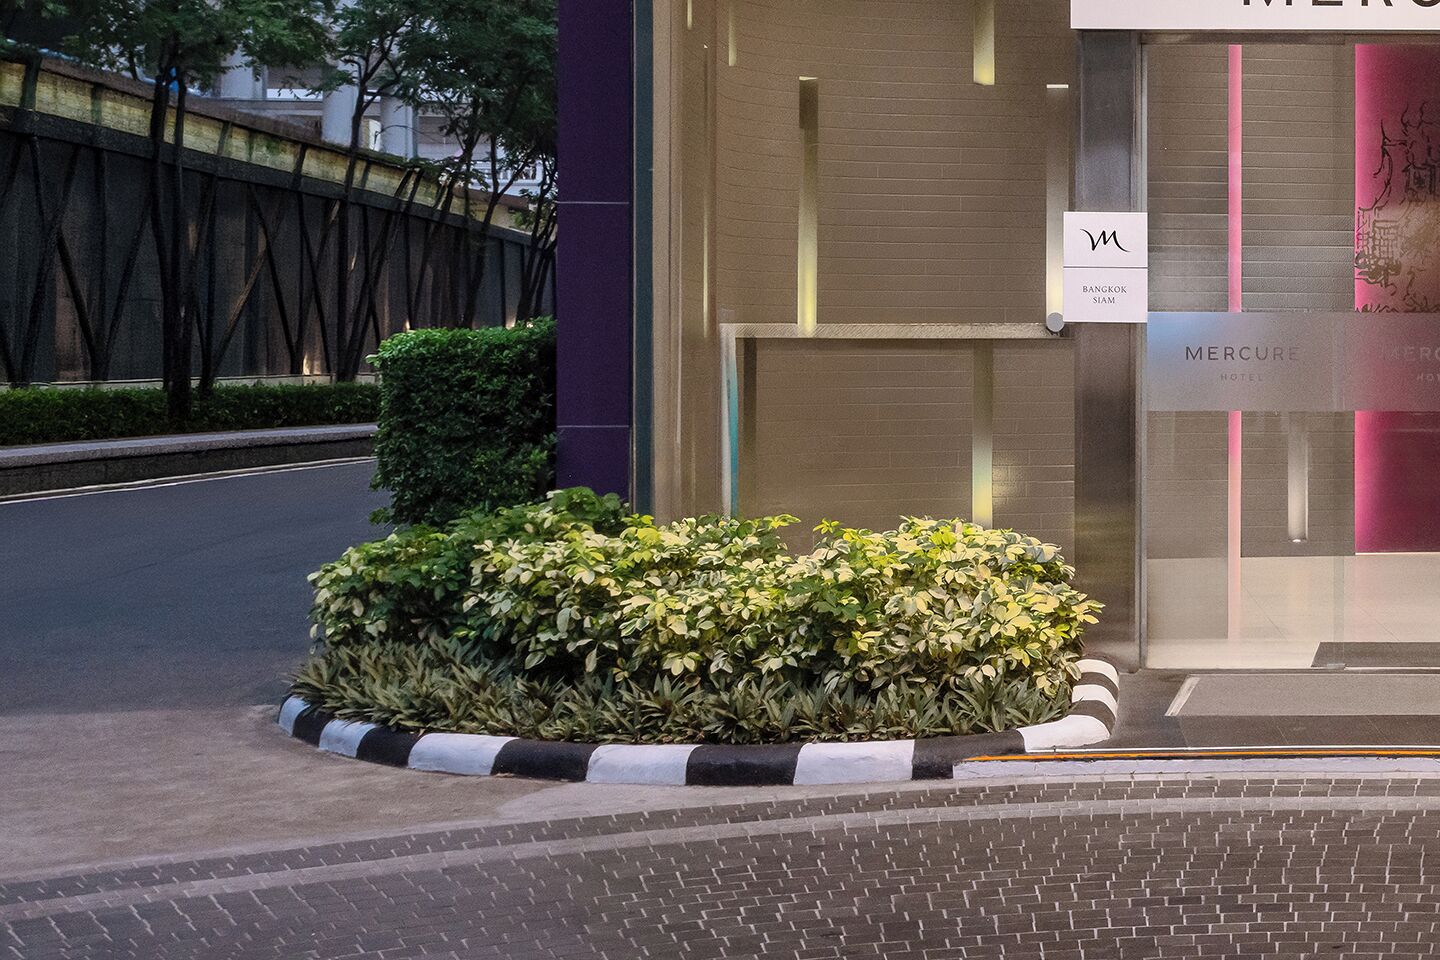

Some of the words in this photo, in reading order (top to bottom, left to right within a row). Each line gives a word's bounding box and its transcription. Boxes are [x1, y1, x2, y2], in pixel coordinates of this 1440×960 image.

[1082, 285, 1127, 294] BANGKOK
[1093, 296, 1116, 304] SIAM
[1185, 345, 1300, 361] MERCURE
[1220, 373, 1263, 382] HOTEL
